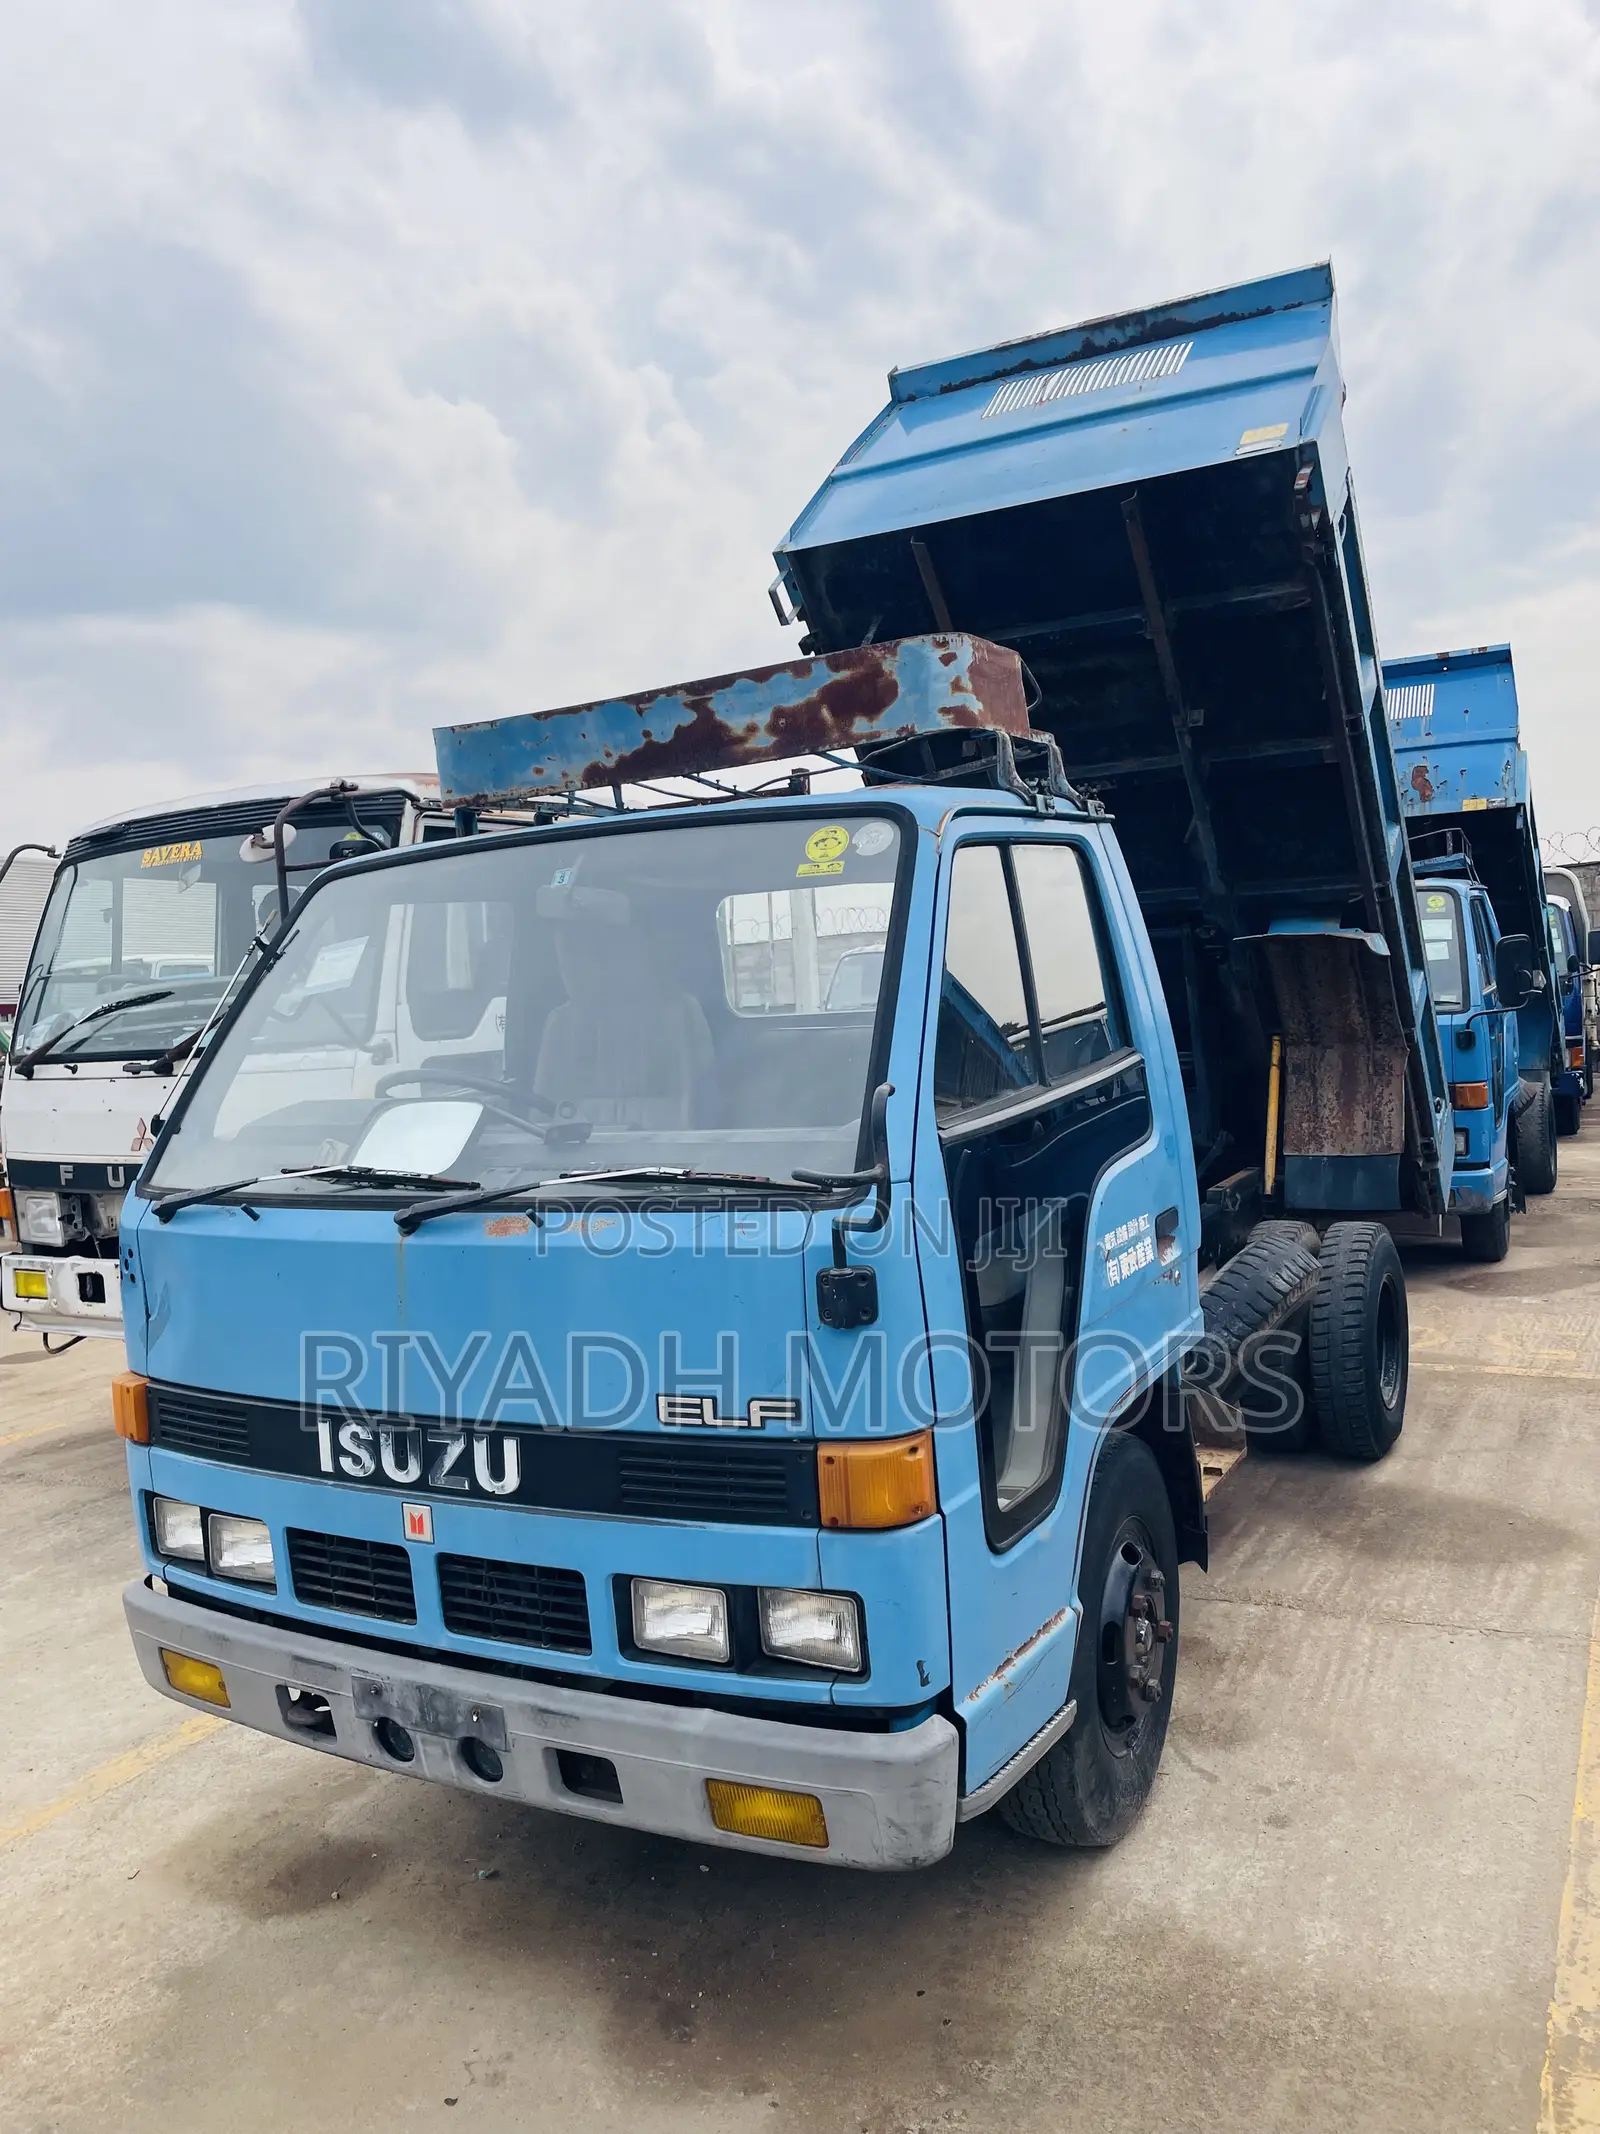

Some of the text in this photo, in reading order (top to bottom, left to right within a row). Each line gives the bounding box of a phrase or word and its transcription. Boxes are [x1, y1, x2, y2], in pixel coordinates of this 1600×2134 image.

[141, 840, 203, 865] SAVERA
[657, 1395, 797, 1429] ELF
[316, 1417, 523, 1495] ISUZU
